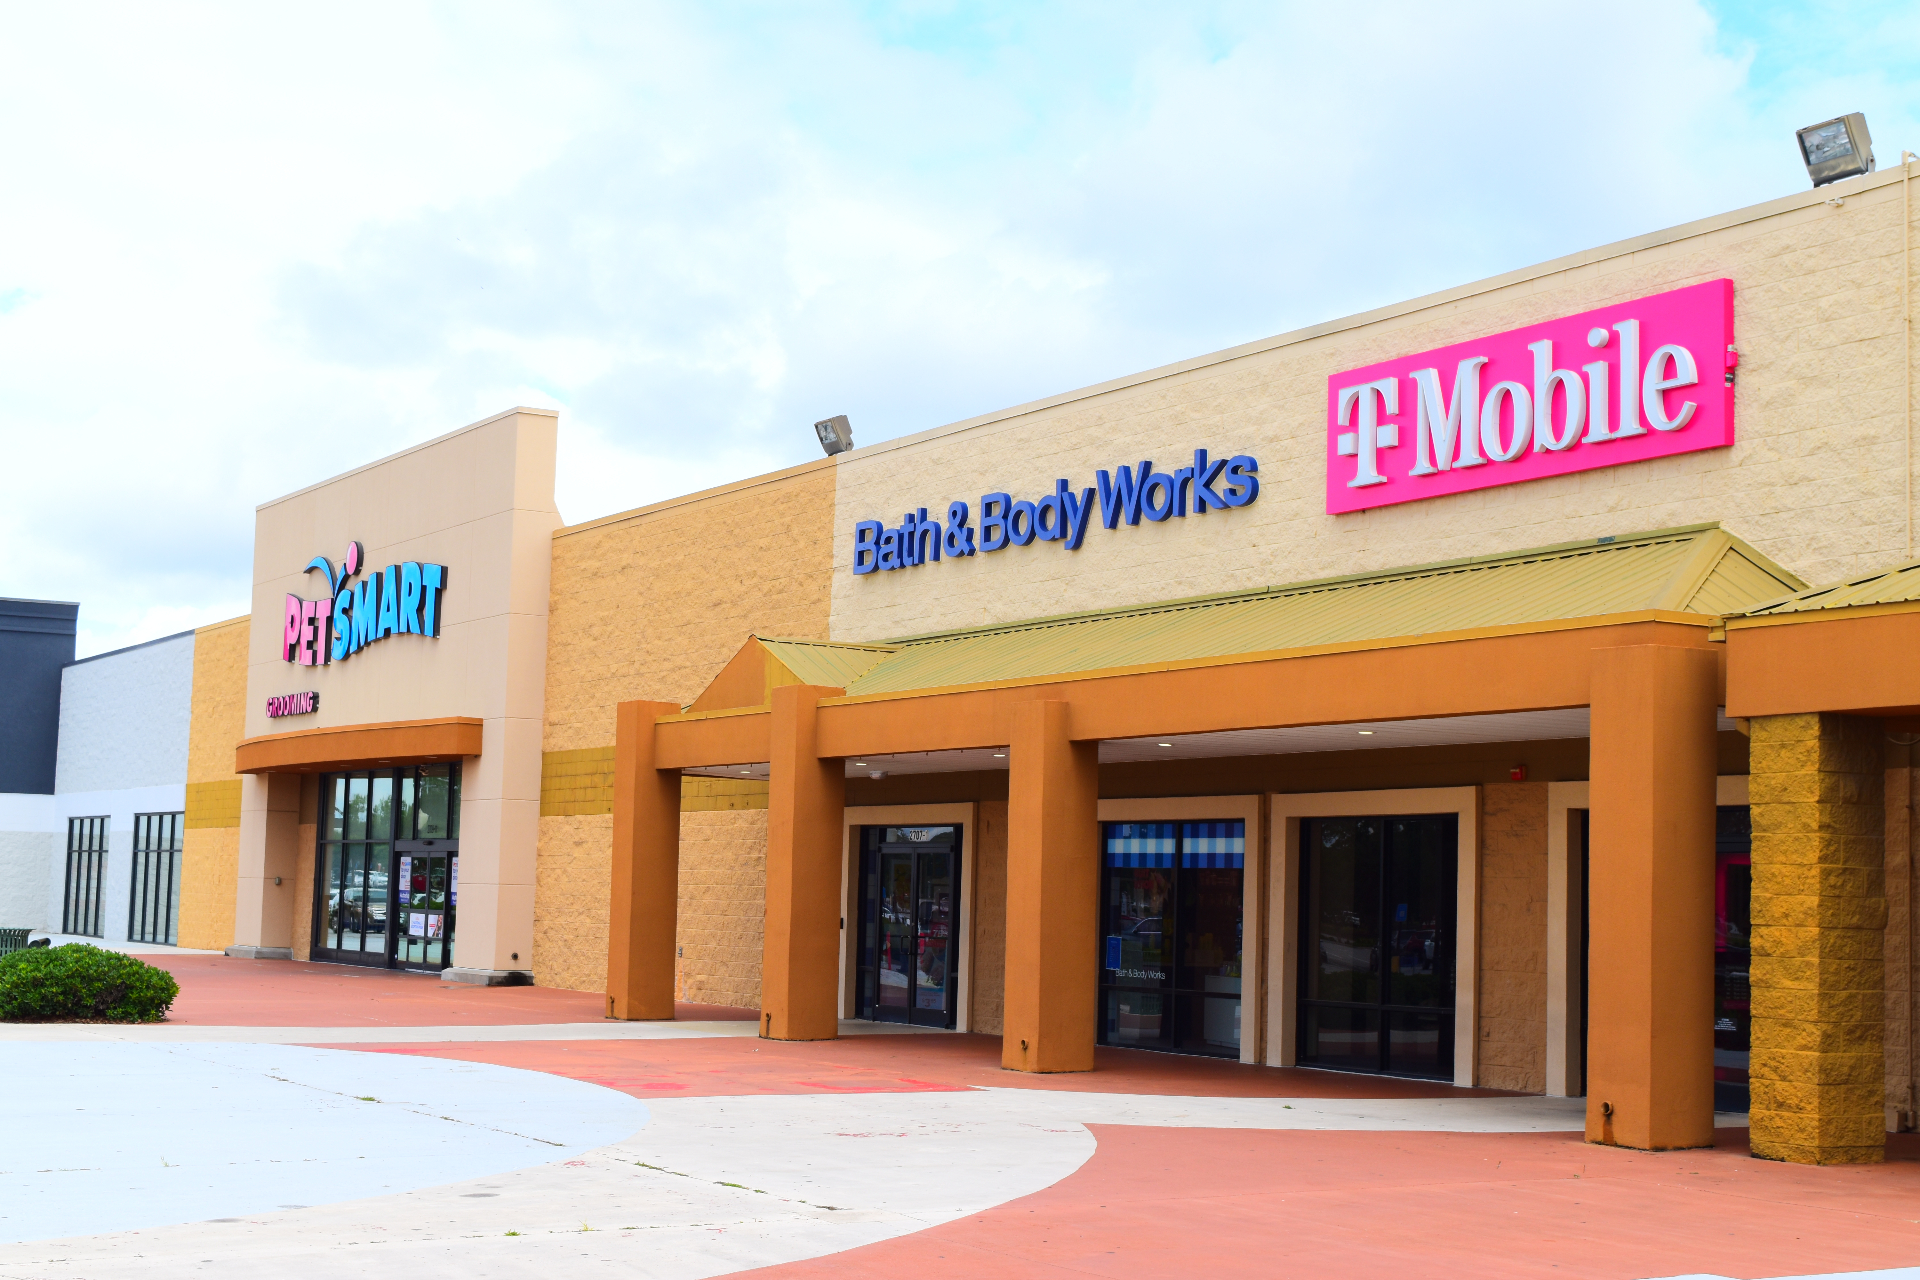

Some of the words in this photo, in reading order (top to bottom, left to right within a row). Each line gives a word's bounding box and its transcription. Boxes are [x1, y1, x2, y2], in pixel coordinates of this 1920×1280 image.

[1408, 319, 1699, 478] Mobile
[853, 507, 941, 575] Bath
[943, 500, 976, 558] &
[979, 478, 1096, 550] Body
[1096, 448, 1260, 530] Works
[266, 691, 319, 718] GROOMING
[1115, 969, 1128, 977] Bath
[1133, 969, 1148, 980] Body
[1147, 970, 1166, 980] Works
